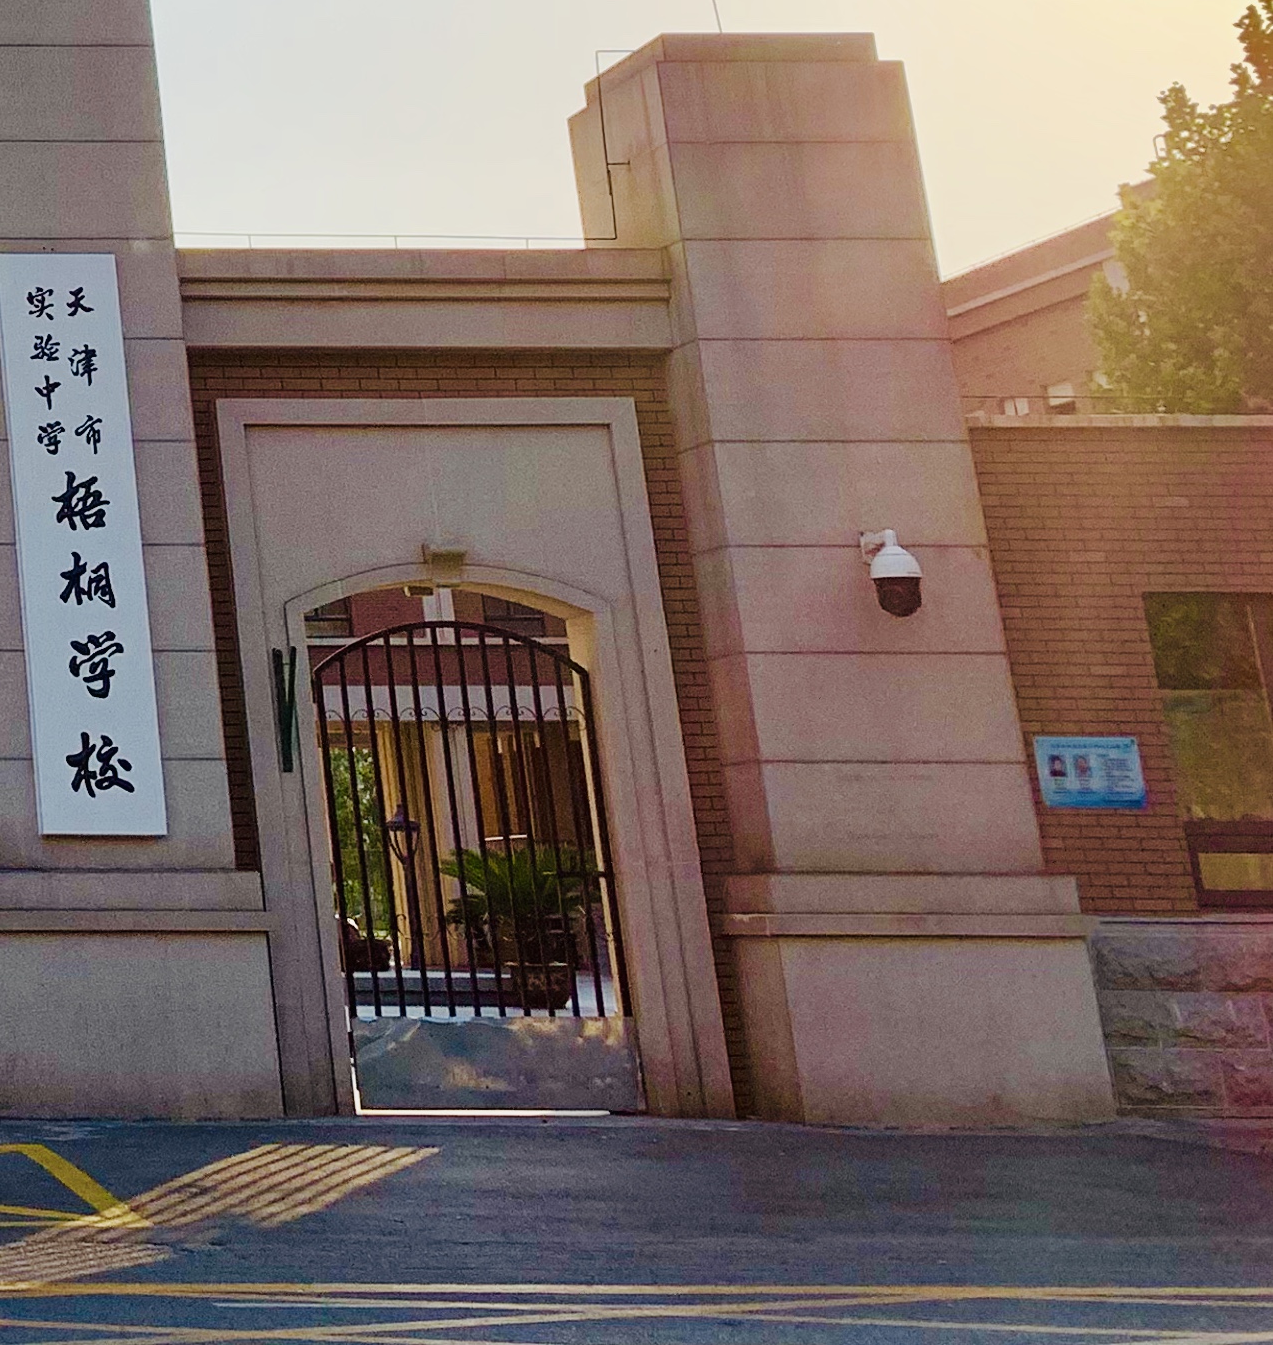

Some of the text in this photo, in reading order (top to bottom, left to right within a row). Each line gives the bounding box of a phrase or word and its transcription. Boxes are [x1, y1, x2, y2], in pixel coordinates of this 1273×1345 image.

[25, 286, 64, 456] 实验中学
[64, 285, 105, 455] 天津市
[51, 470, 136, 799] 梧桐学校
